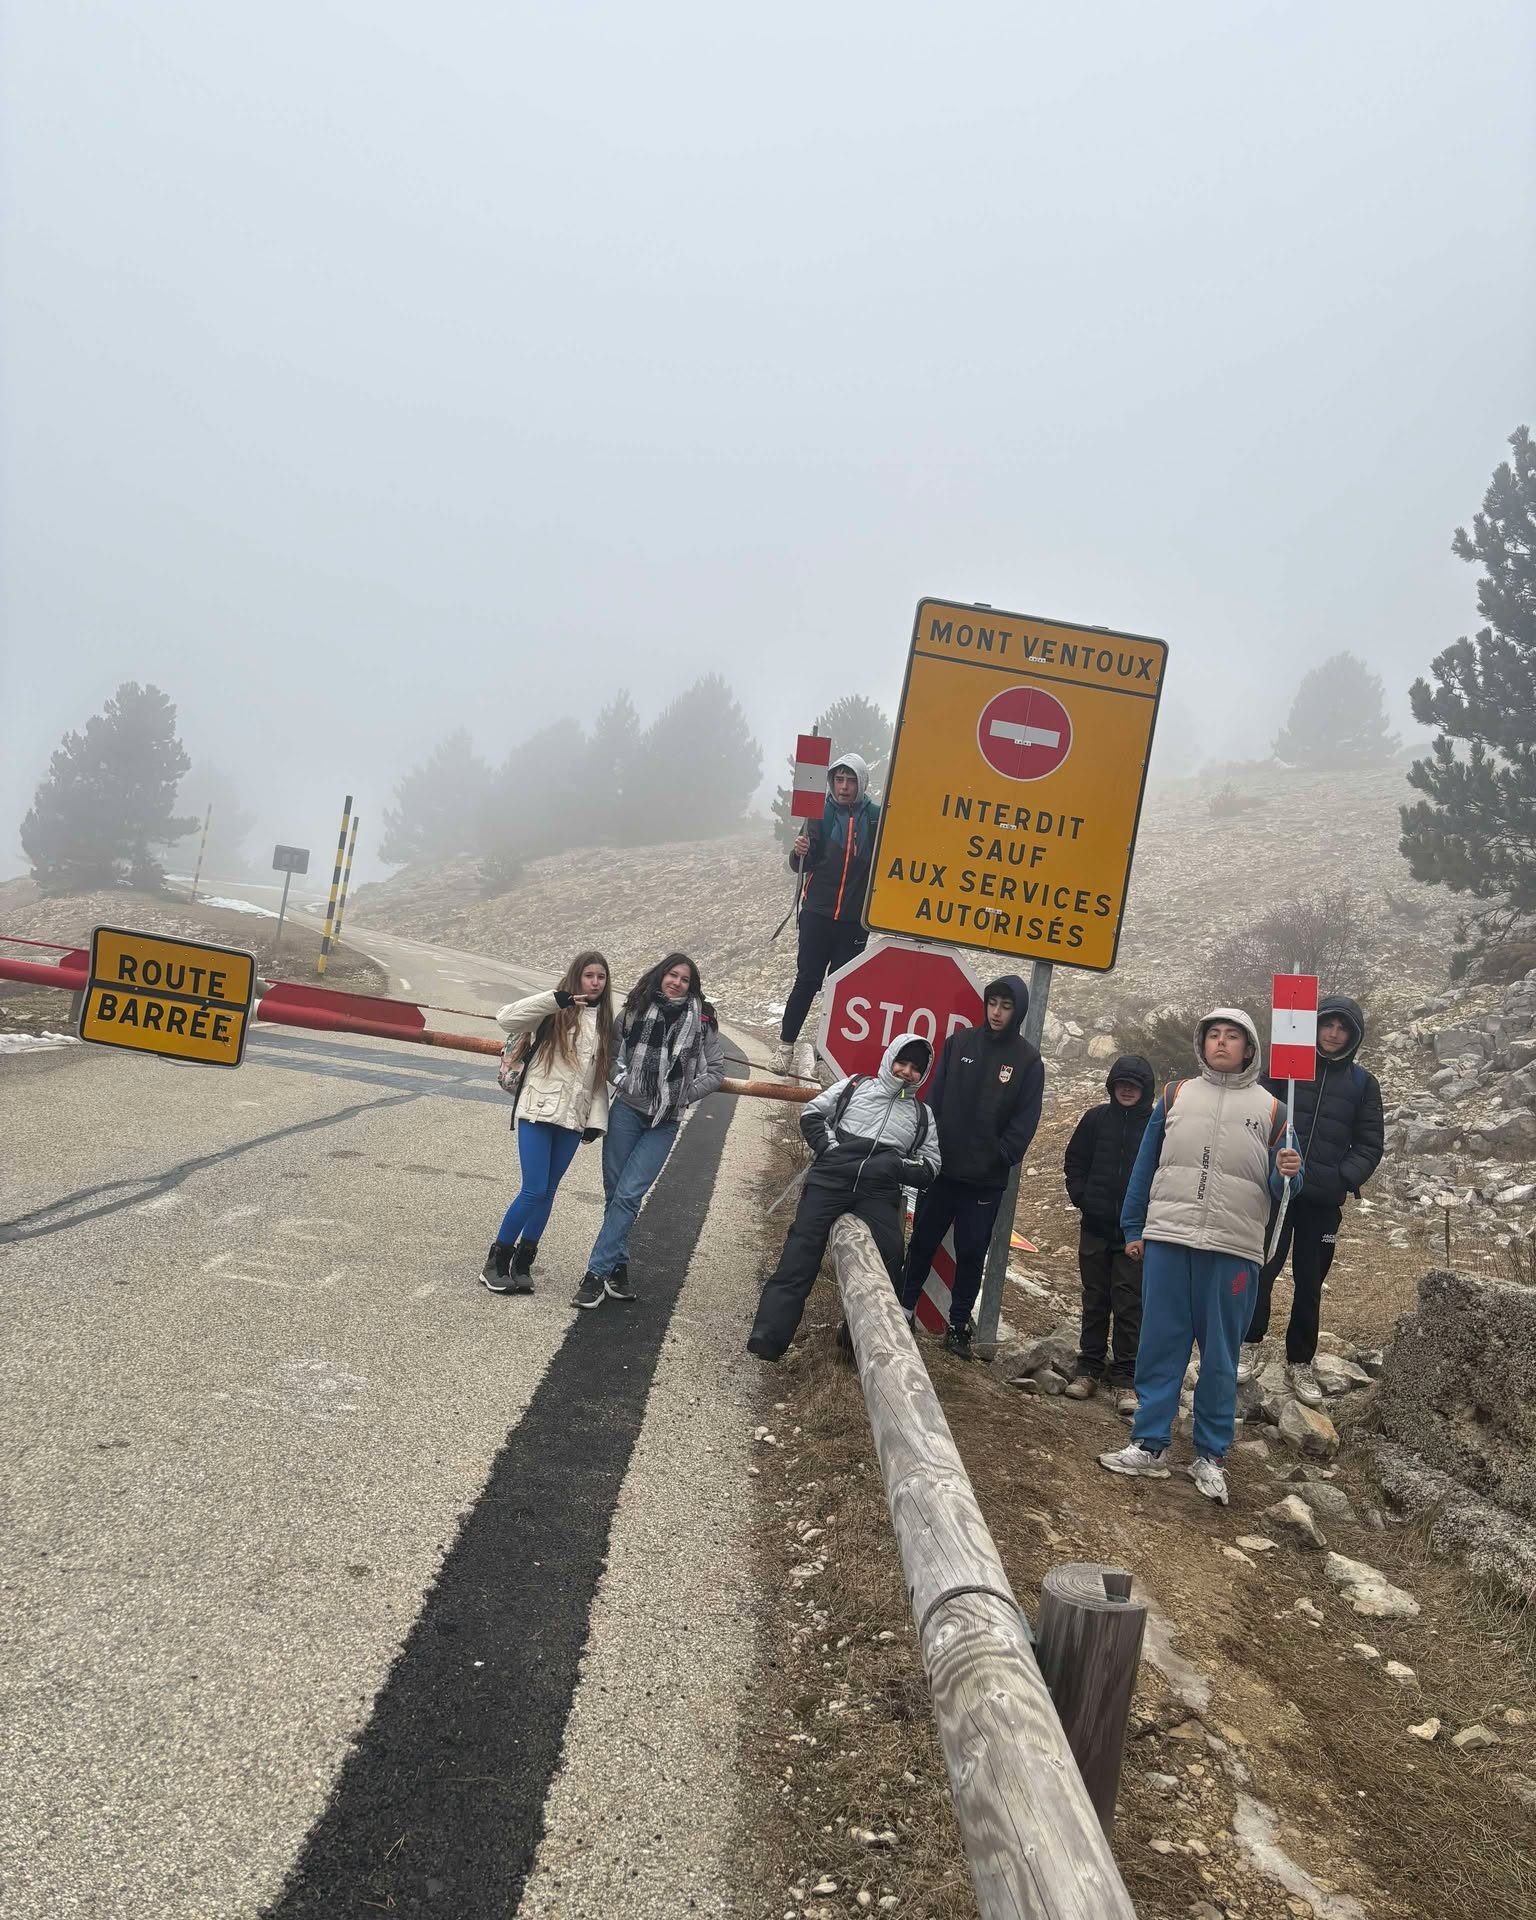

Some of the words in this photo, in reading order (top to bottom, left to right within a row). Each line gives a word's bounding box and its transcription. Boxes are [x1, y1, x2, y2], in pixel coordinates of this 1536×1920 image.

[929, 619, 1012, 654] MONT
[1023, 635, 1154, 681] VENTOUX
[942, 795, 1085, 840] INTERDIT
[967, 836, 1047, 868] SAUF
[888, 858, 947, 888] AUX
[959, 870, 1112, 917] SERVICES
[915, 898, 1084, 948] AUTORISÉS
[118, 954, 227, 999] ROUTE
[97, 993, 232, 1043] BARRÉE
[1202, 1146, 1211, 1170] UNDER
[1197, 1170, 1208, 1200] ARMOUR
